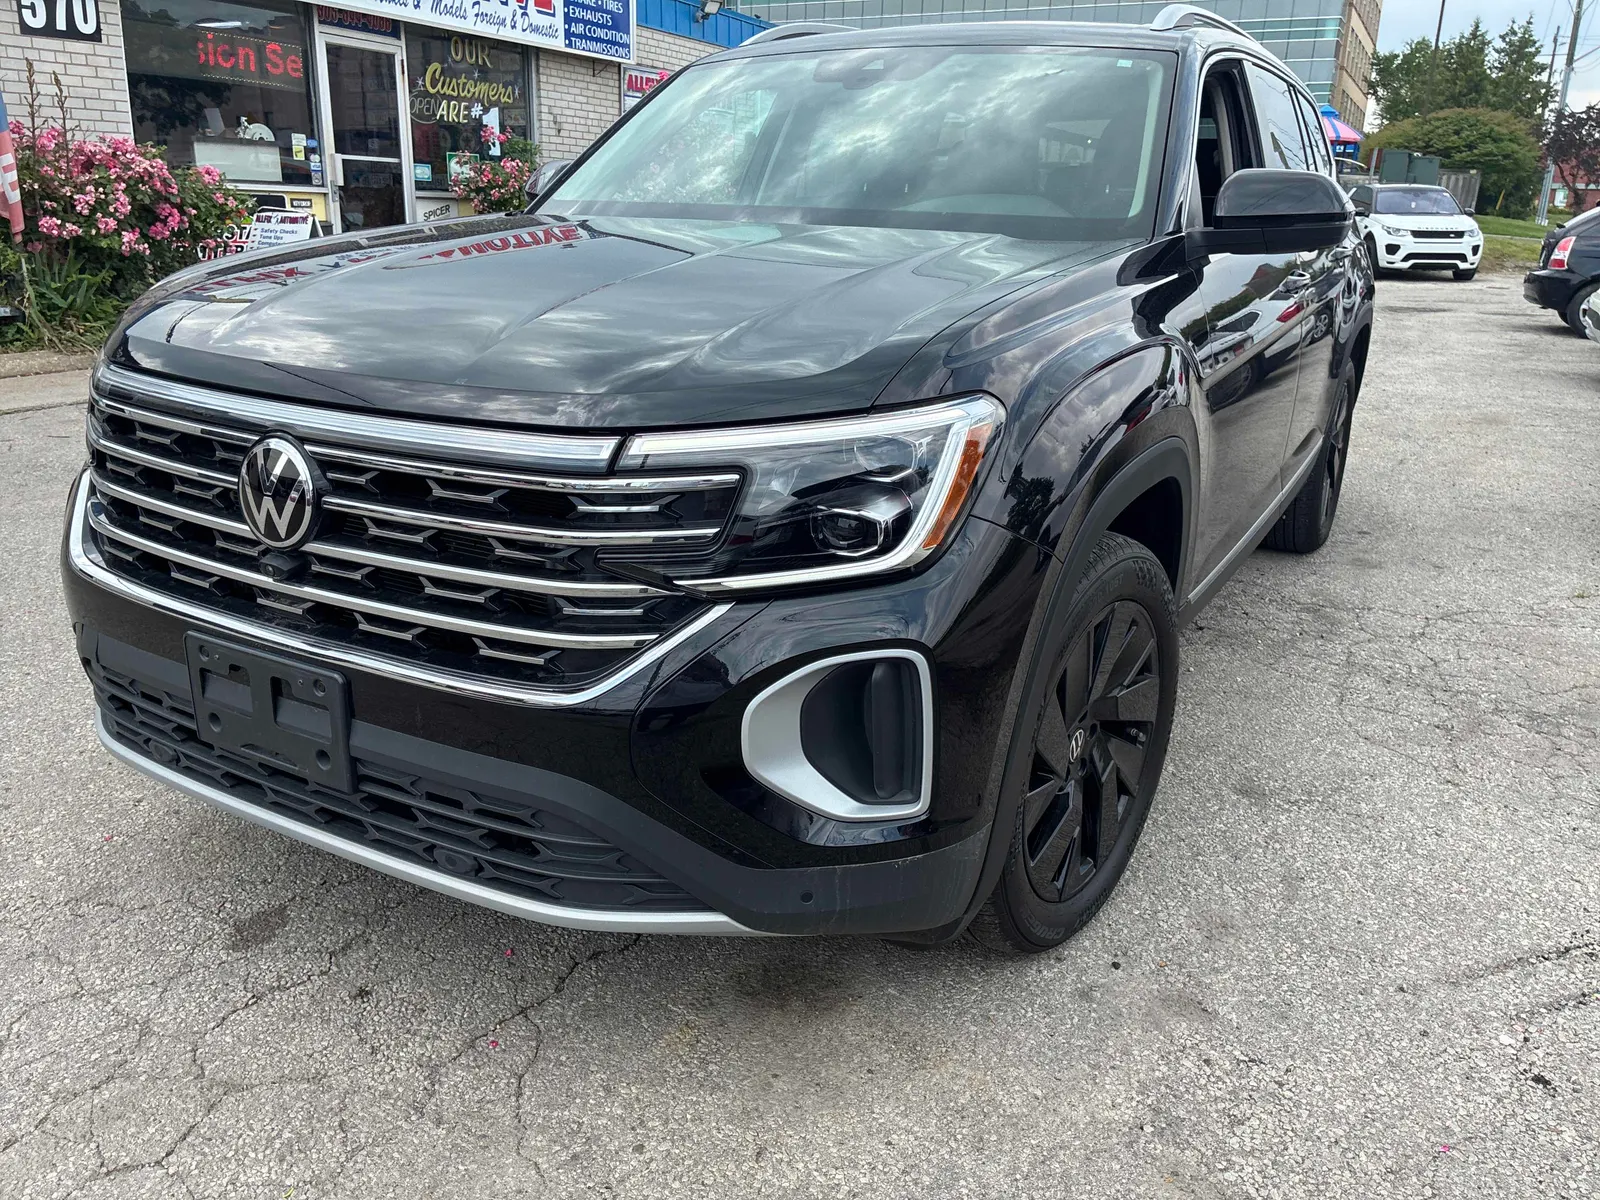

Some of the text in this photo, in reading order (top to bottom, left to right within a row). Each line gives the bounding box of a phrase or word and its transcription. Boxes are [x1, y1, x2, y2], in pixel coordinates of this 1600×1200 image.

[569, 5, 613, 26] EXHAUSTS
[603, 0, 624, 13] TIRES
[472, 0, 507, 34] Foreign
[510, 9, 518, 30] &
[520, 11, 560, 39] Domestic
[570, 22, 630, 45] AIR CONDITION
[570, 37, 630, 59] TRANMISSIONS
[425, 62, 514, 107] Customers
[408, 97, 440, 116] OPEN
[436, 99, 469, 123] ARE
[423, 204, 451, 221] SPICER
[260, 227, 278, 236] Safety
